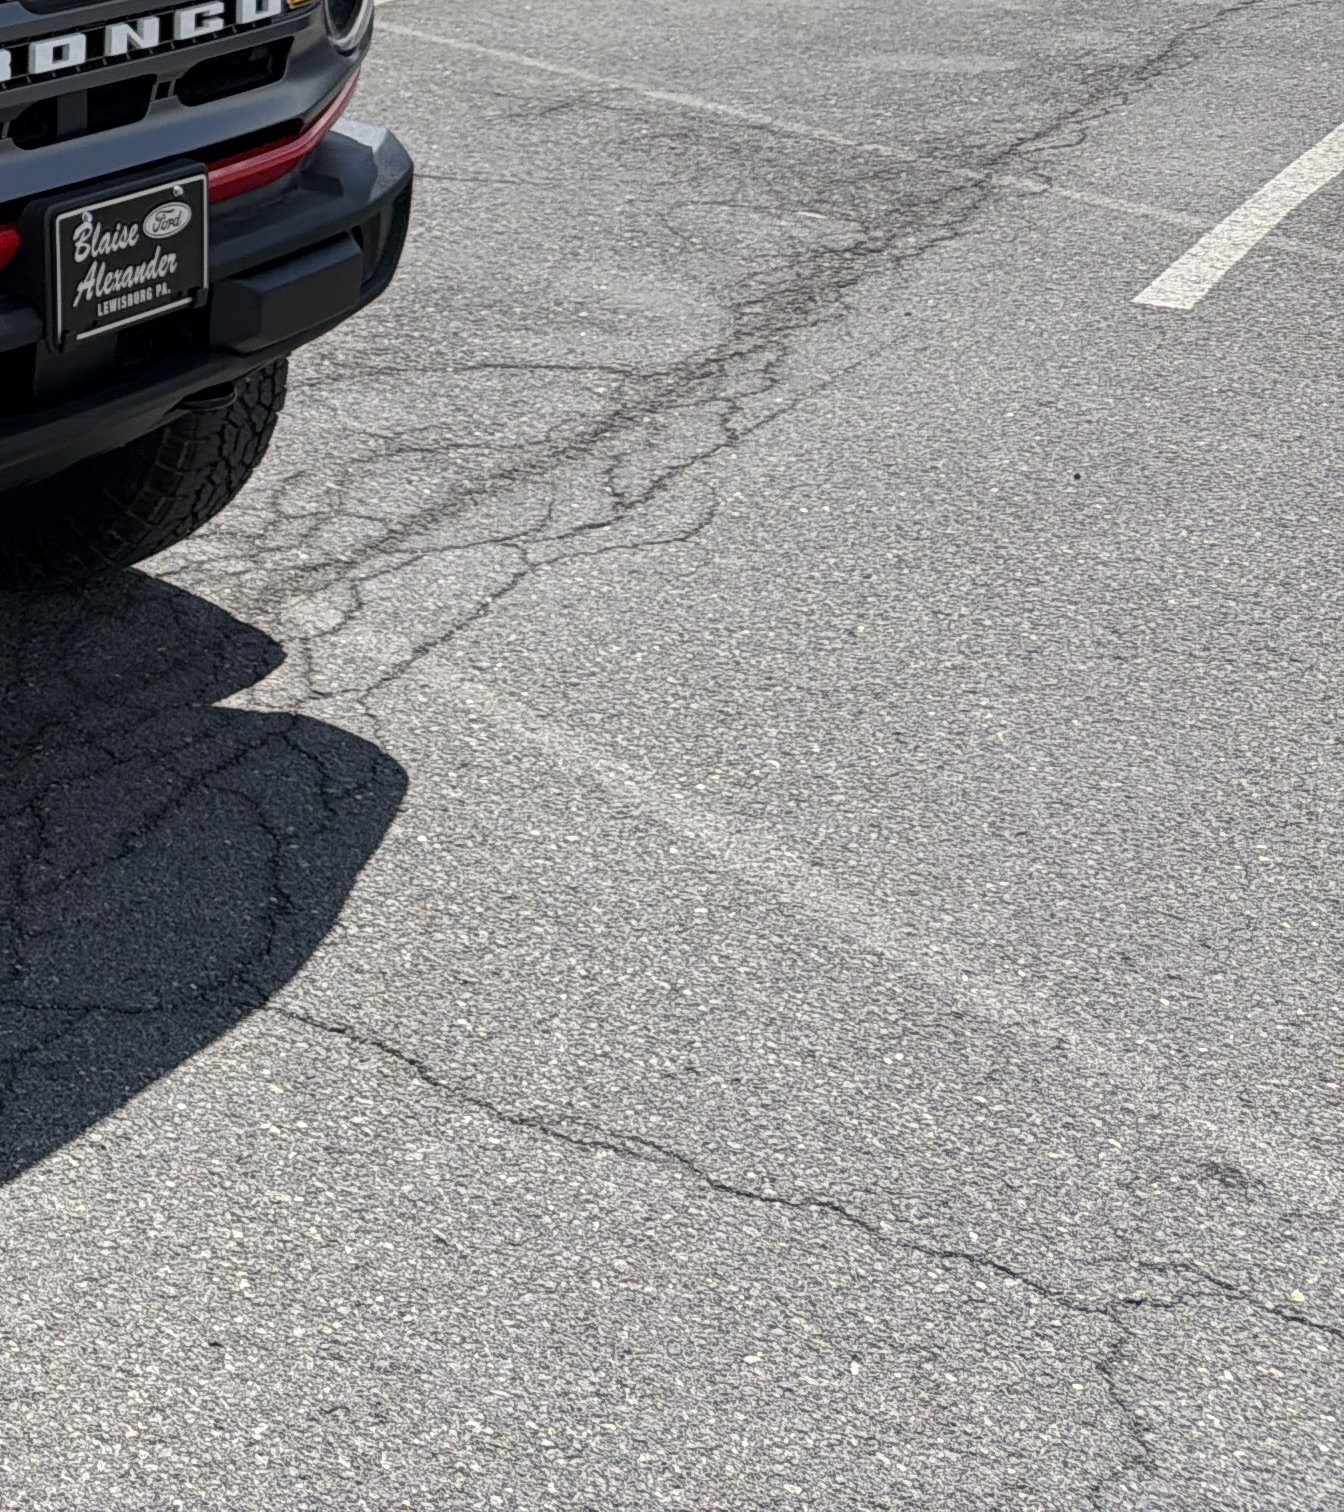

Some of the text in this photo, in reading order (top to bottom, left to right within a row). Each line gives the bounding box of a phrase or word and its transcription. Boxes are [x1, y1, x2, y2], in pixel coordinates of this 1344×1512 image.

[72, 221, 140, 263] Blaise
[72, 245, 179, 308] Alexander
[97, 282, 172, 317] LEWISBURG PA.
